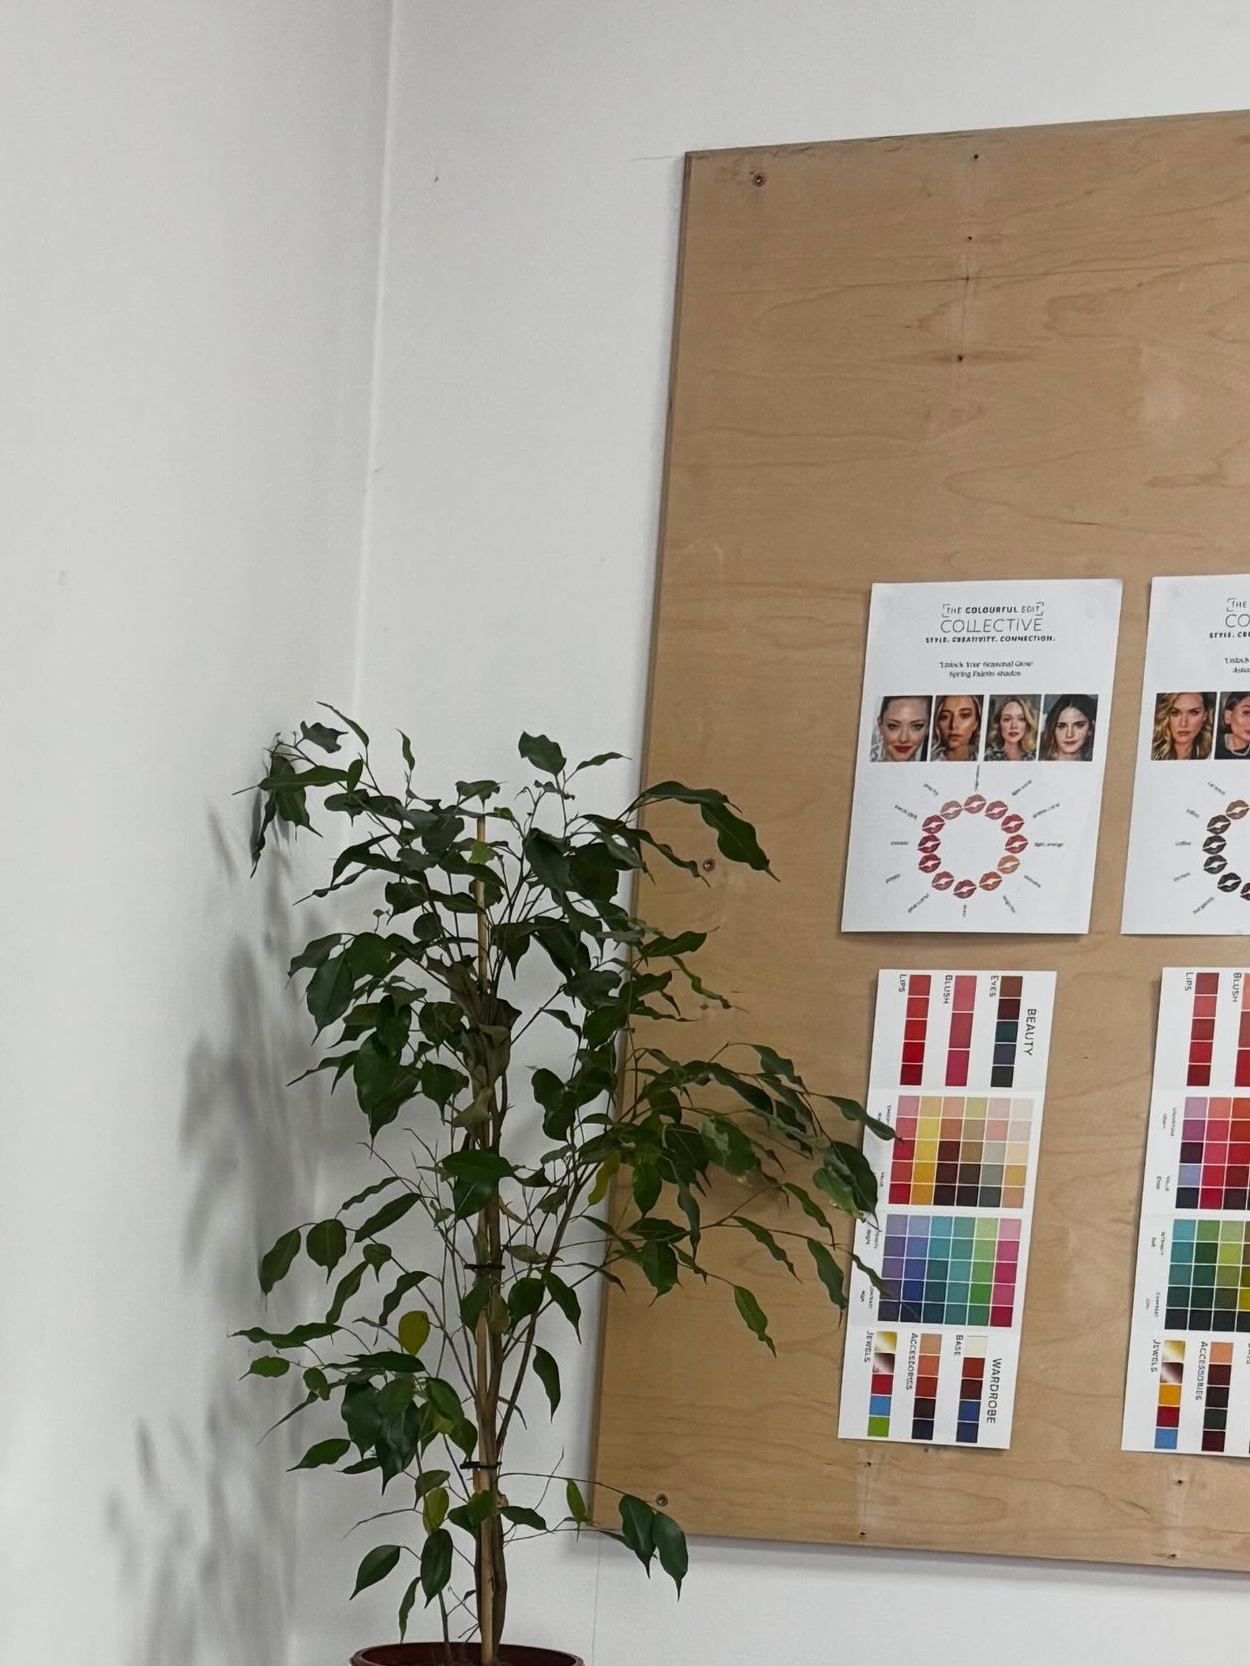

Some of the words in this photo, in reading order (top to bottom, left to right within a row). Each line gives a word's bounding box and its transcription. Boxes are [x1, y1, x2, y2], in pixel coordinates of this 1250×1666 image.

[940, 618, 1043, 633] COLLECTIVE
[946, 606, 962, 615] THE
[965, 605, 1018, 614] COLOURFUL
[1021, 605, 1041, 614] EDIT
[1023, 1007, 1037, 1056] BEAUTY
[864, 1330, 874, 1363] JEWELS
[906, 1332, 918, 1391] ACCESSORIES
[1150, 1339, 1161, 1373] JEWELS
[986, 1357, 1003, 1426] WARDROBE
[1195, 1341, 1208, 1401] ACCESSORIES
